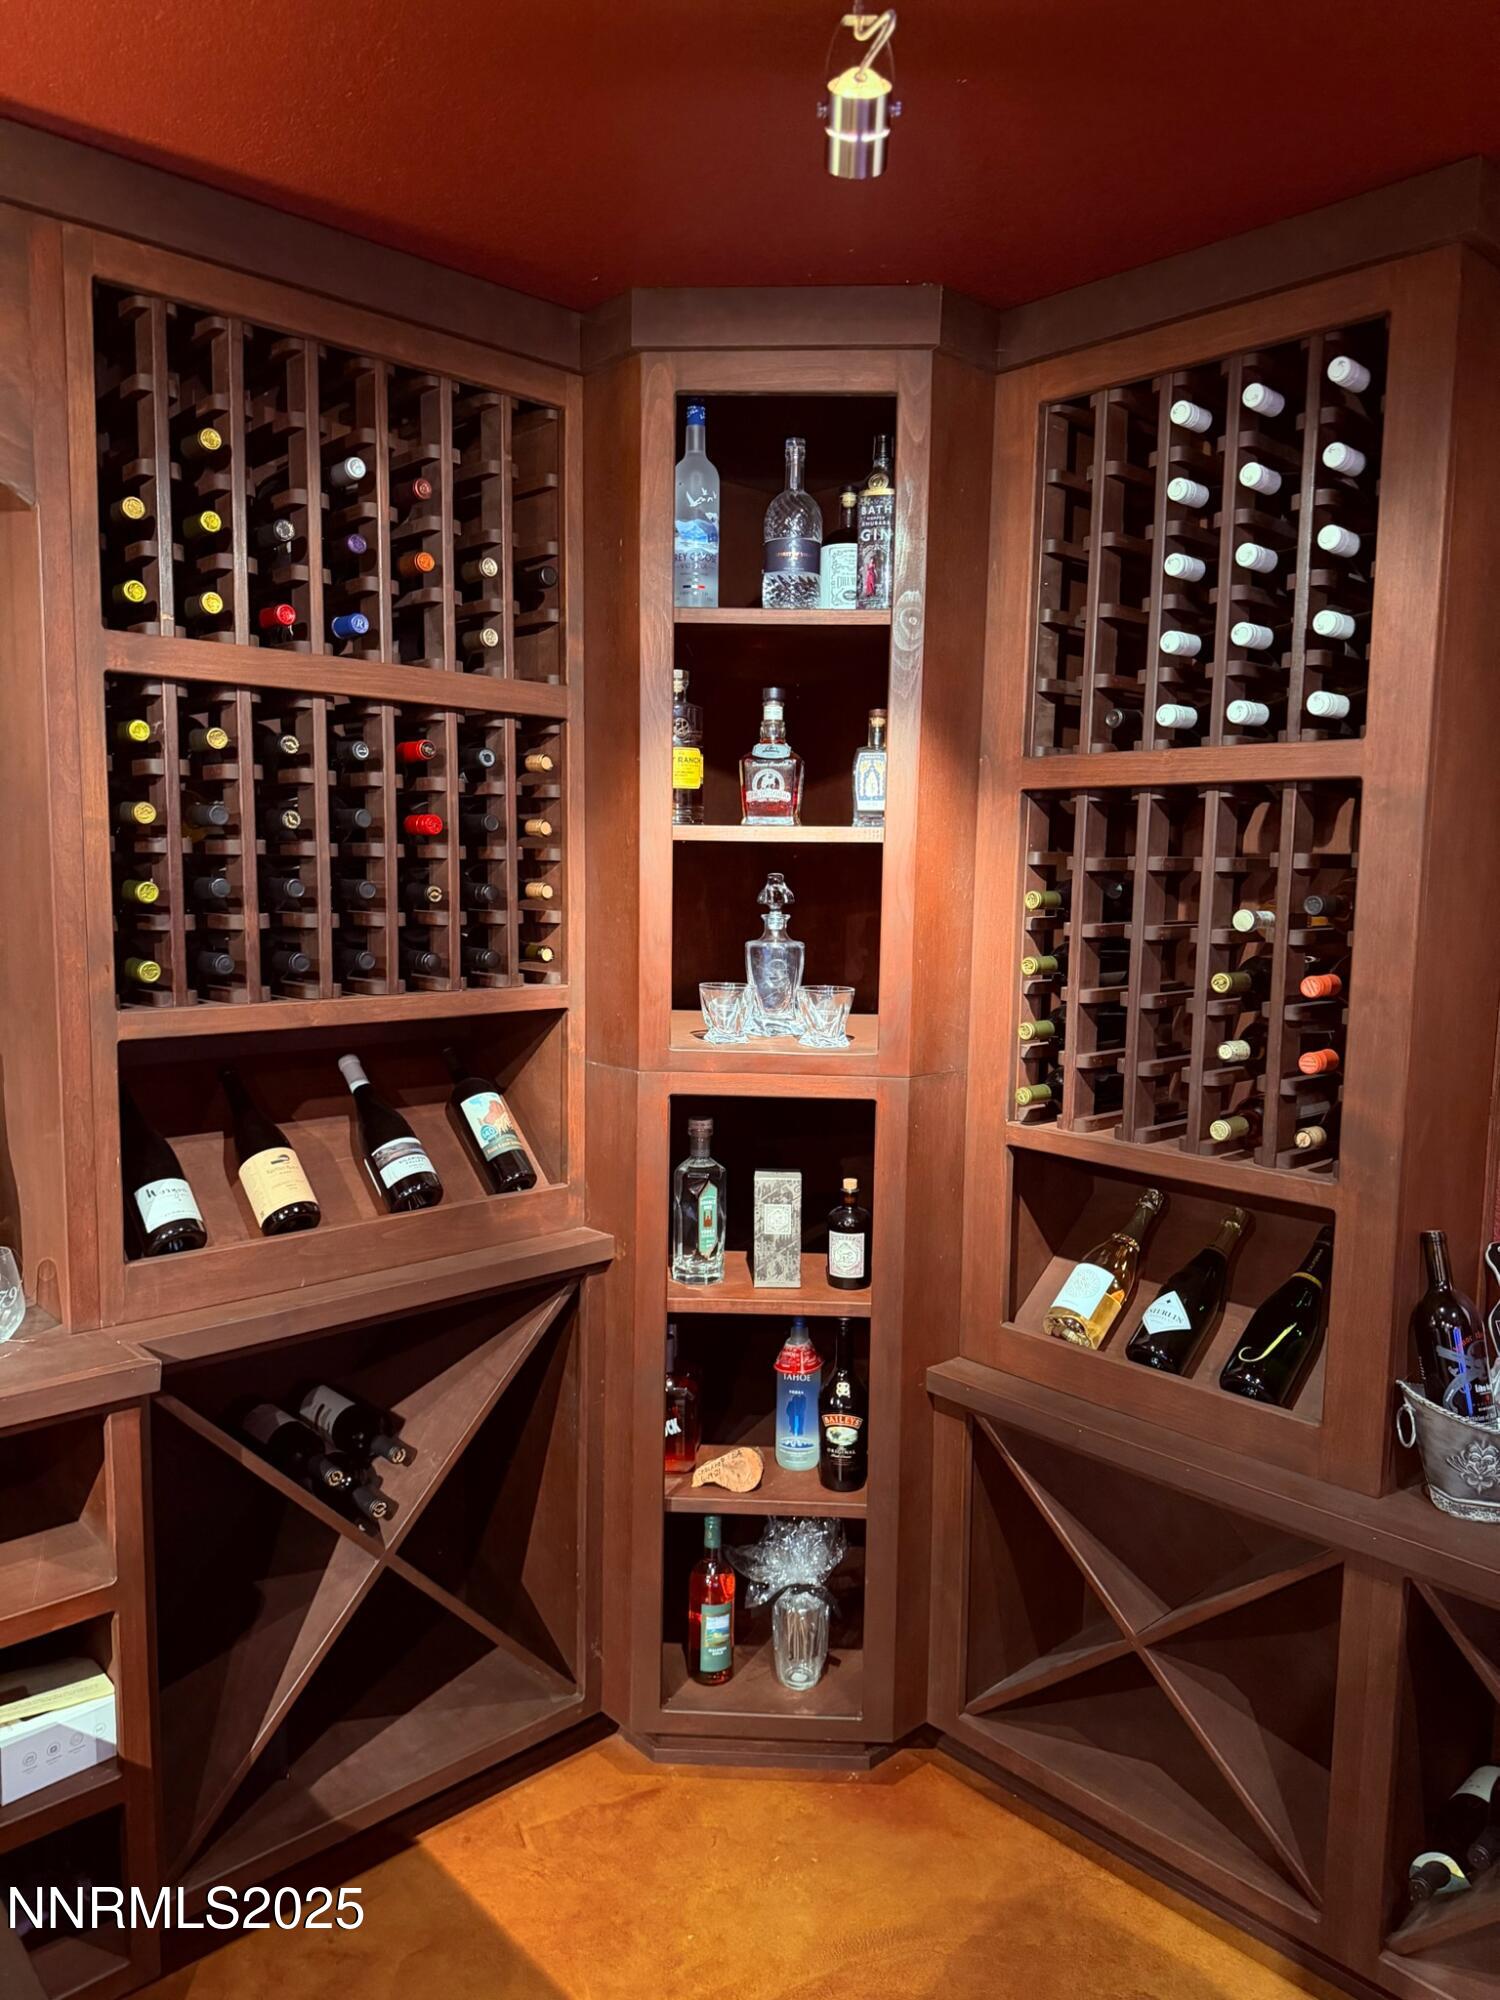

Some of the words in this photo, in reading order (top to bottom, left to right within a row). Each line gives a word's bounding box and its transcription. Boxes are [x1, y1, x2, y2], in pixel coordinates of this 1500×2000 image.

[861, 505, 892, 515] BATH
[860, 527, 892, 542] GIN
[783, 1373, 811, 1382] TAHOE
[824, 1415, 860, 1427] BAILEYS
